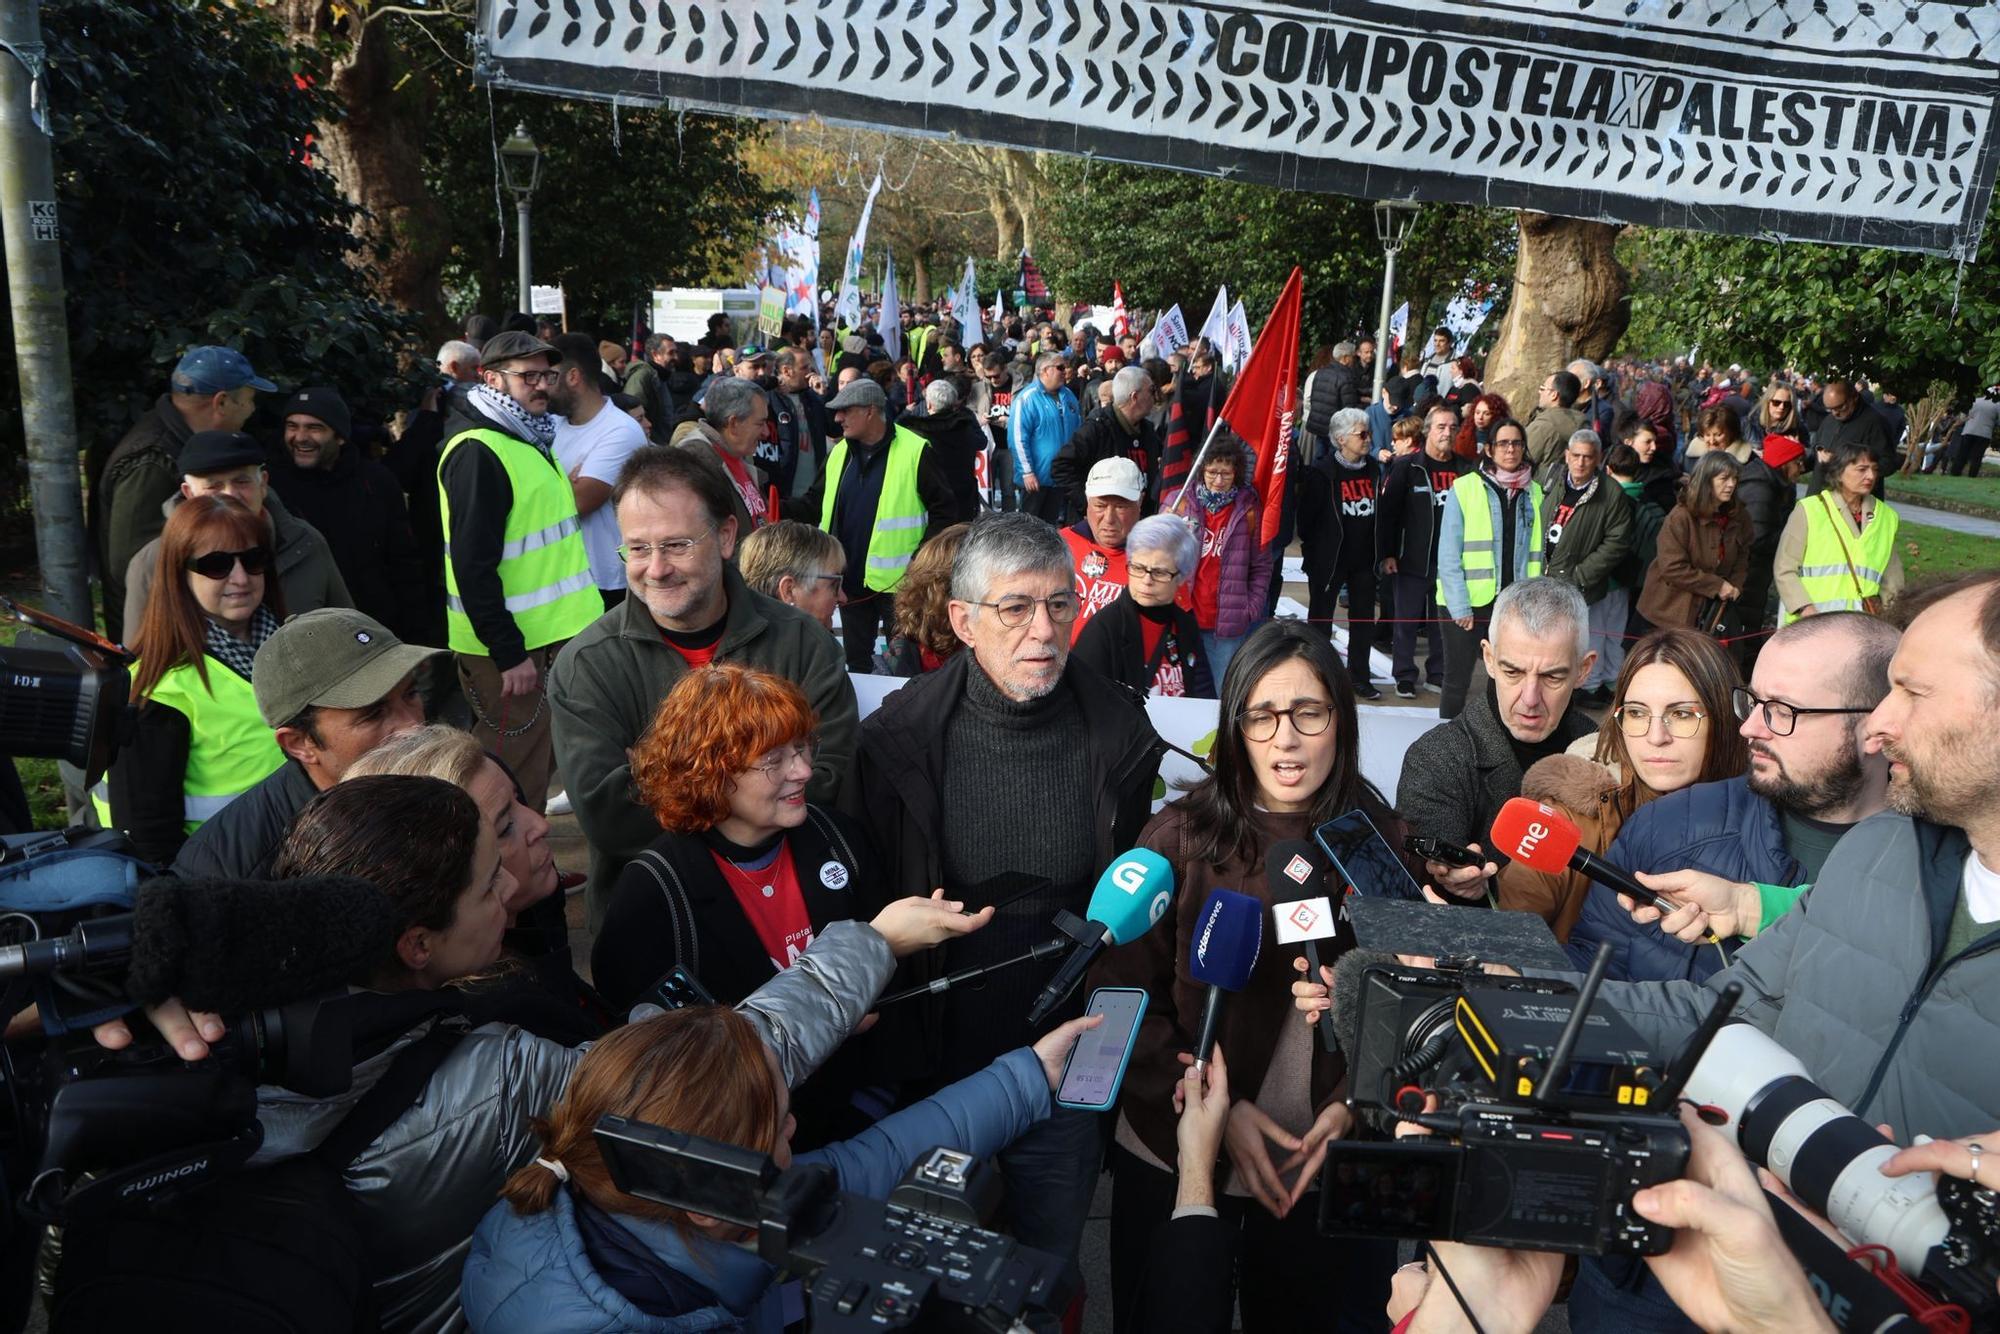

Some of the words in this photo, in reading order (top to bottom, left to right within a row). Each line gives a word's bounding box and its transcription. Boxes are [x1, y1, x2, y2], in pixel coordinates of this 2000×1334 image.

[1516, 822, 1549, 858] rne
[1197, 900, 1223, 968] Atlasnews
[1480, 1112, 1513, 1121] SONY
[122, 1160, 207, 1196] FUJINON
